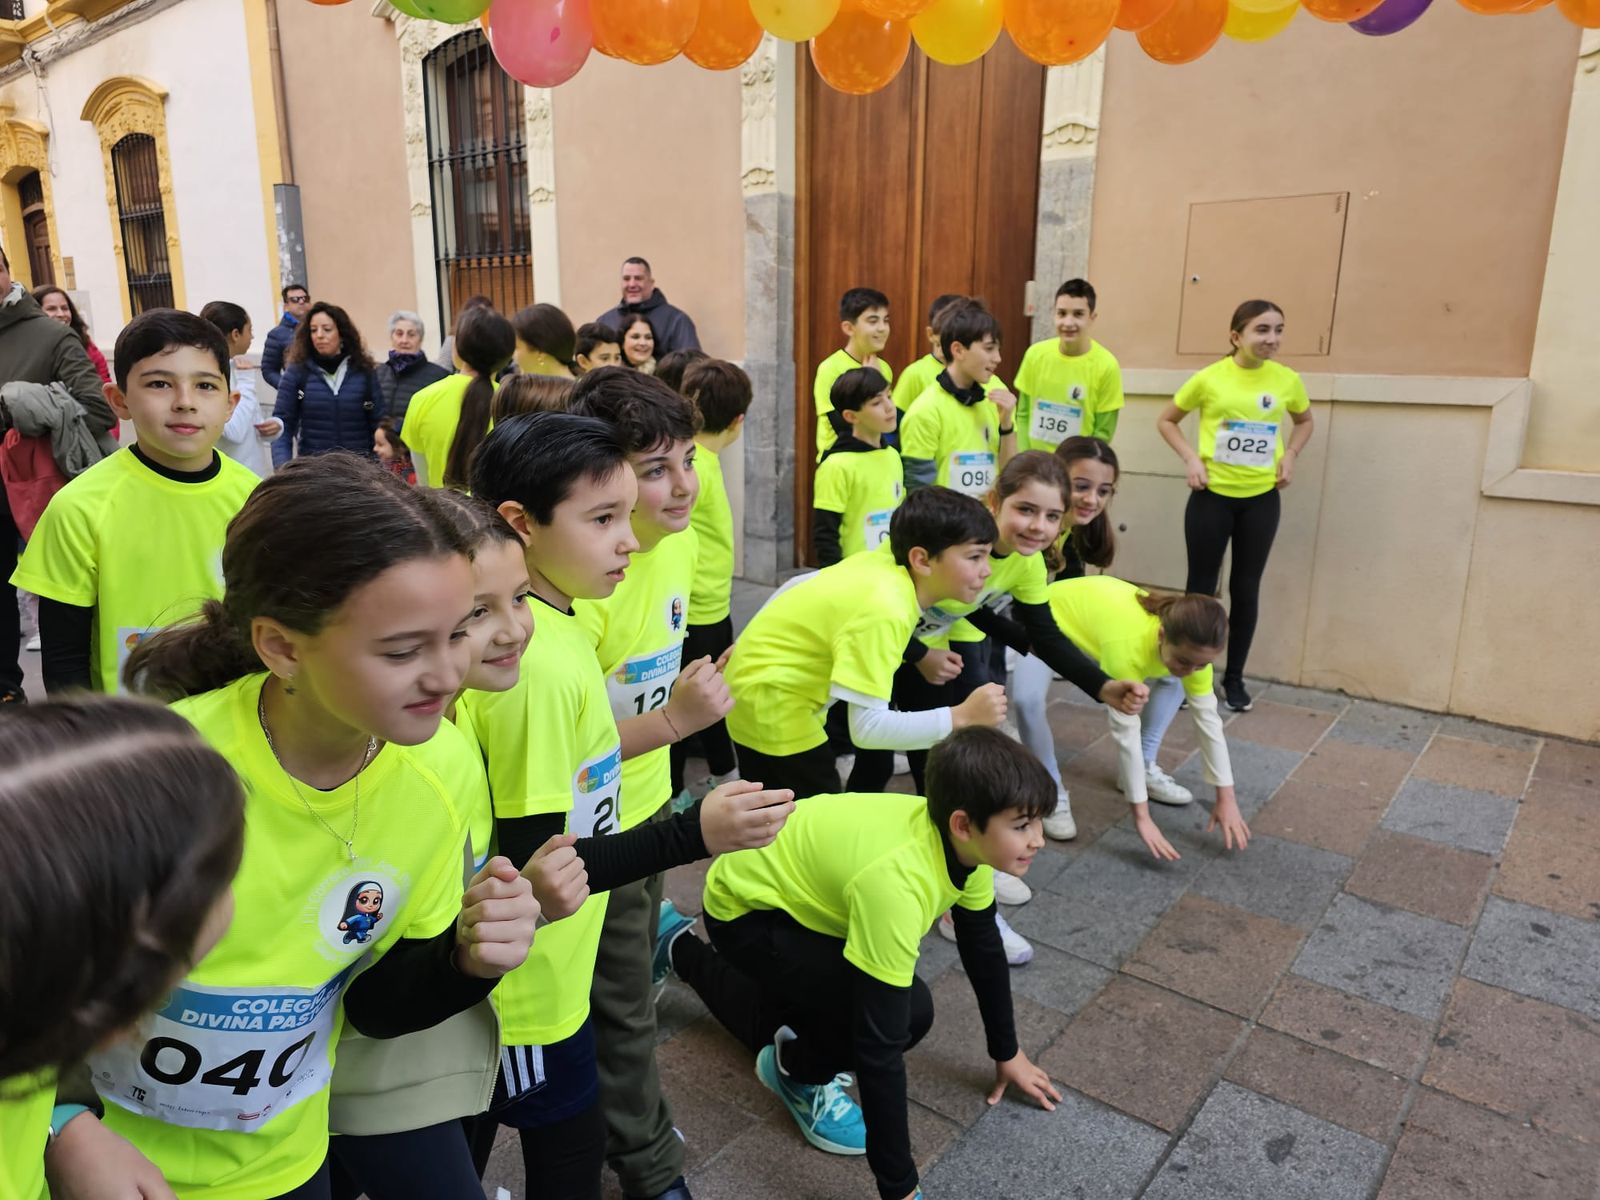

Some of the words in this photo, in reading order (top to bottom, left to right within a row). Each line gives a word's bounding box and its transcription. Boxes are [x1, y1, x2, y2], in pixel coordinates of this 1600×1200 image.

[1039, 416, 1068, 433] 136
[1227, 437, 1268, 454] 022
[231, 987, 327, 1014] COLEGIO
[180, 1008, 263, 1030] DIVINA
[140, 1031, 316, 1096] 040
